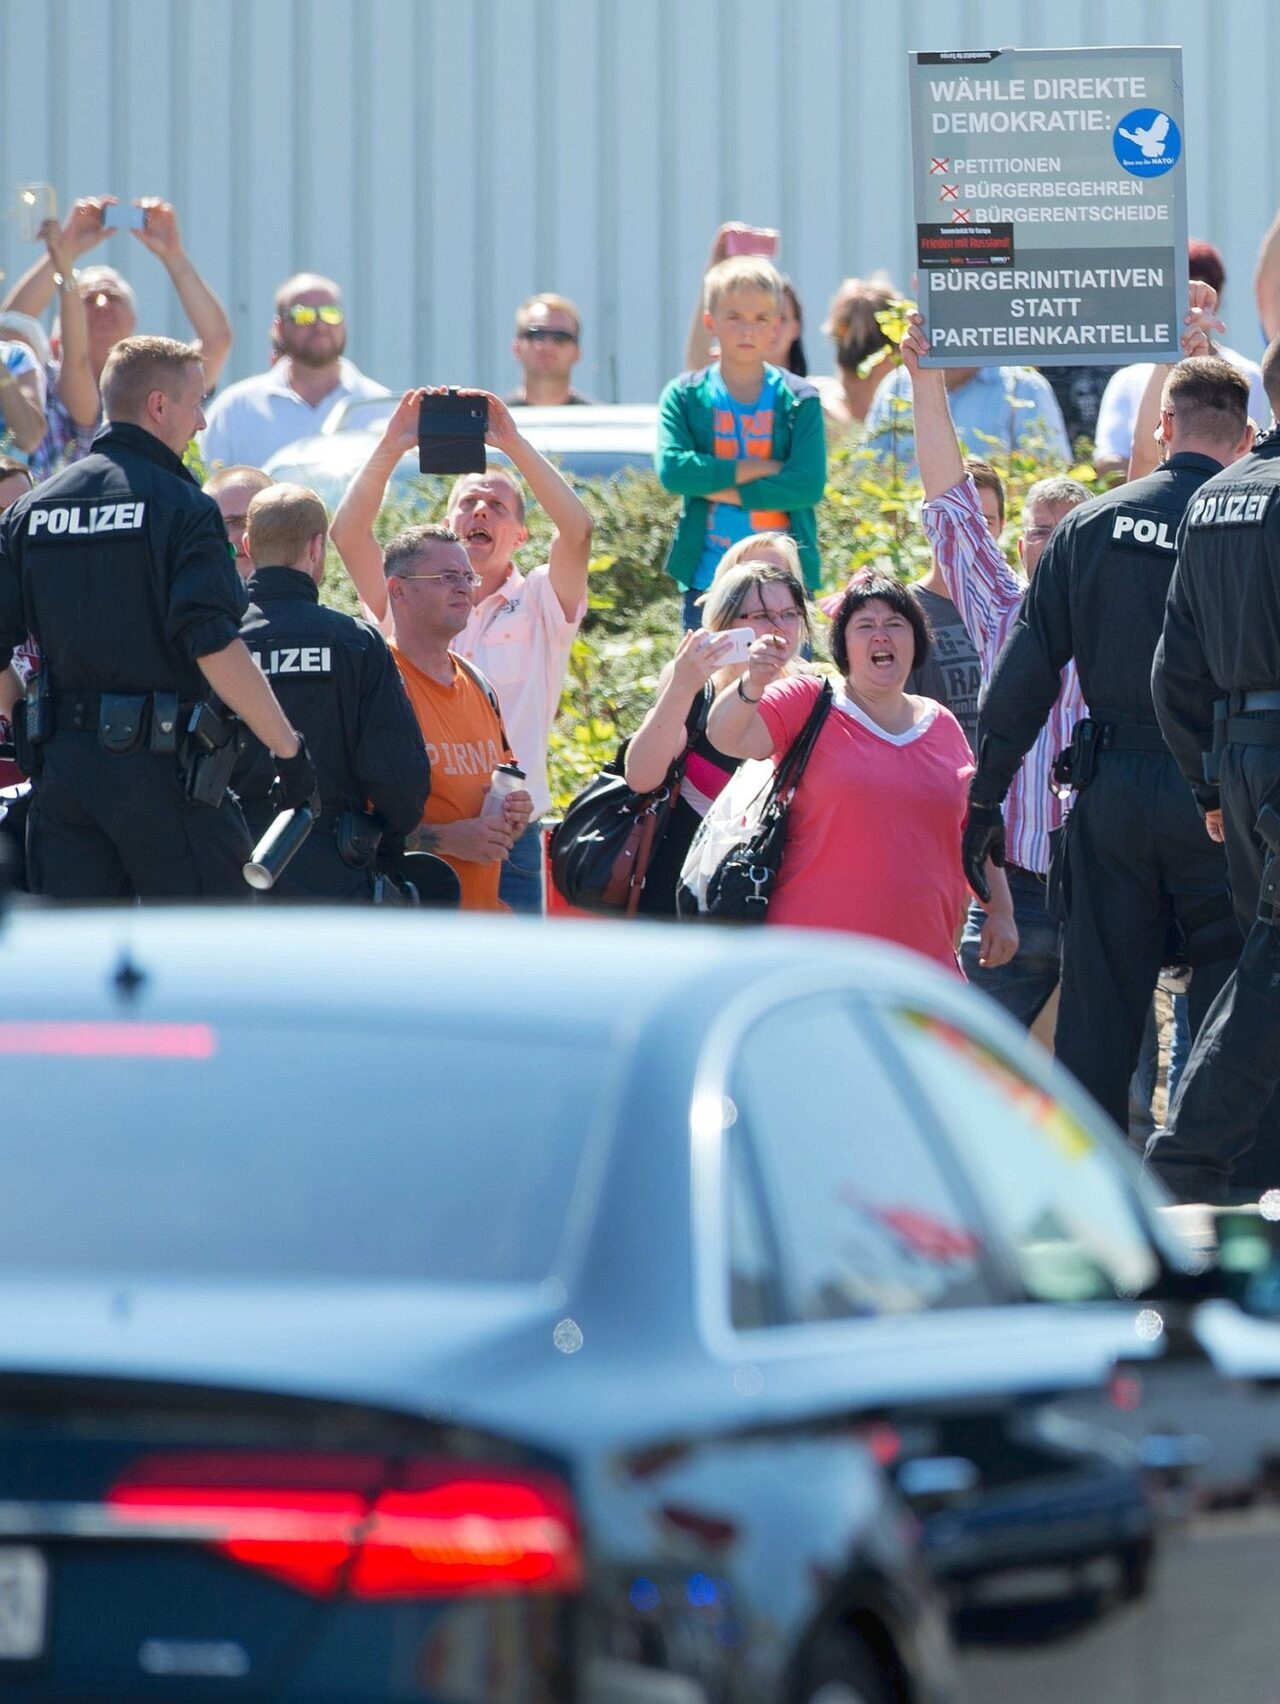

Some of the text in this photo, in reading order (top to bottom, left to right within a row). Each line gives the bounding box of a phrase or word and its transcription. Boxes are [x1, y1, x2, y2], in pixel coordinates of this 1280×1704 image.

[930, 77, 1146, 102] WÄHLE DIREKTE
[932, 110, 1112, 134] DEMOKRATIE:
[954, 158, 1061, 175] PETITIONEN
[964, 181, 1143, 199] BÜRGERBEGEHREN
[975, 205, 1168, 224] BÜRGERENTSCHEIDE
[930, 268, 1163, 292] BÜRGERINITIATIVEN
[1010, 298, 1081, 318] STATT
[931, 324, 1169, 347] PARTEIENKARTELLE
[28, 502, 145, 536] POLIZEI
[1190, 495, 1271, 524] POLIZEI
[252, 647, 331, 674] LIZEI
[425, 739, 500, 775] PIRNA
